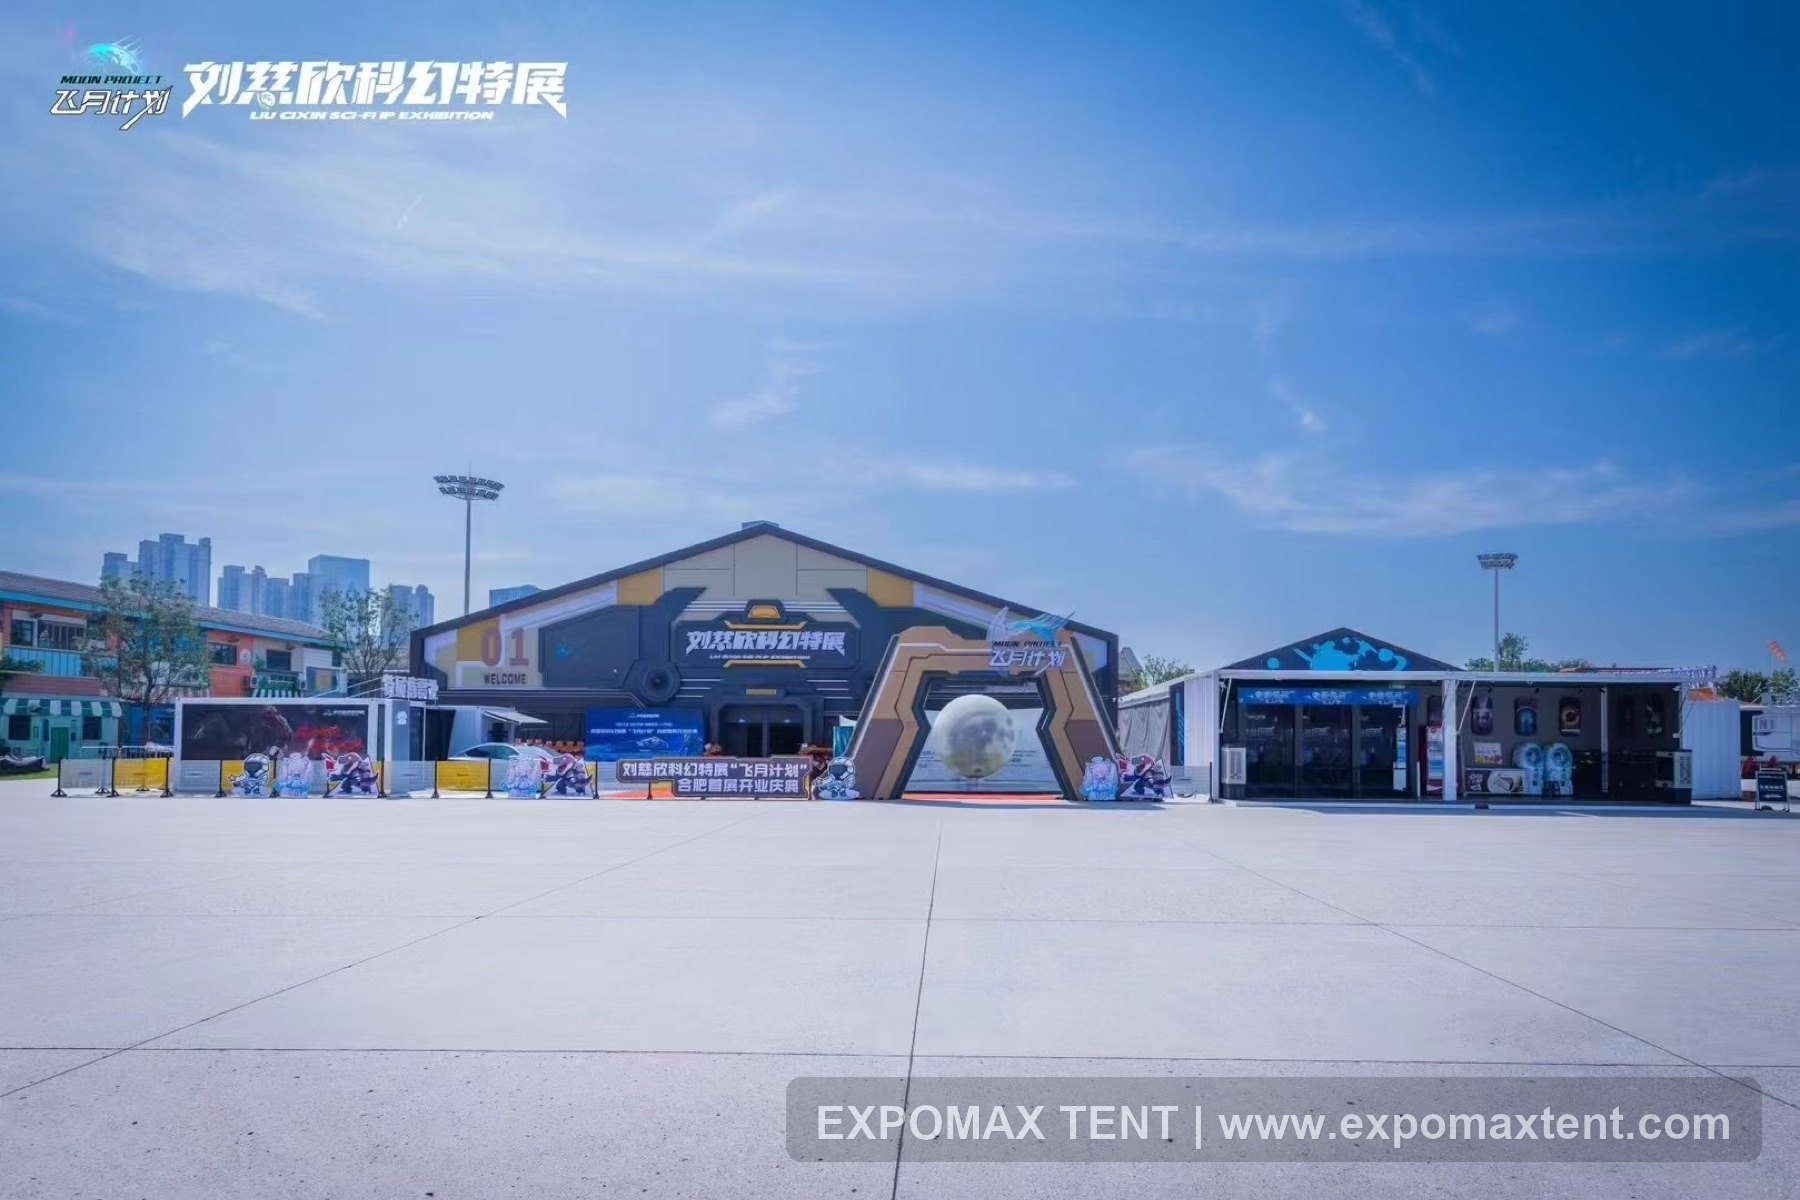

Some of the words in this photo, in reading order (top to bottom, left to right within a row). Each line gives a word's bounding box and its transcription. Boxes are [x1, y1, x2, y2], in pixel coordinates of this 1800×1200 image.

[686, 631, 846, 656] 刘慈欣科幻特展
[989, 650, 1066, 676] 飞月计划
[483, 673, 527, 684] WELCOME
[677, 779, 800, 793] 合肥首展开业庆典
